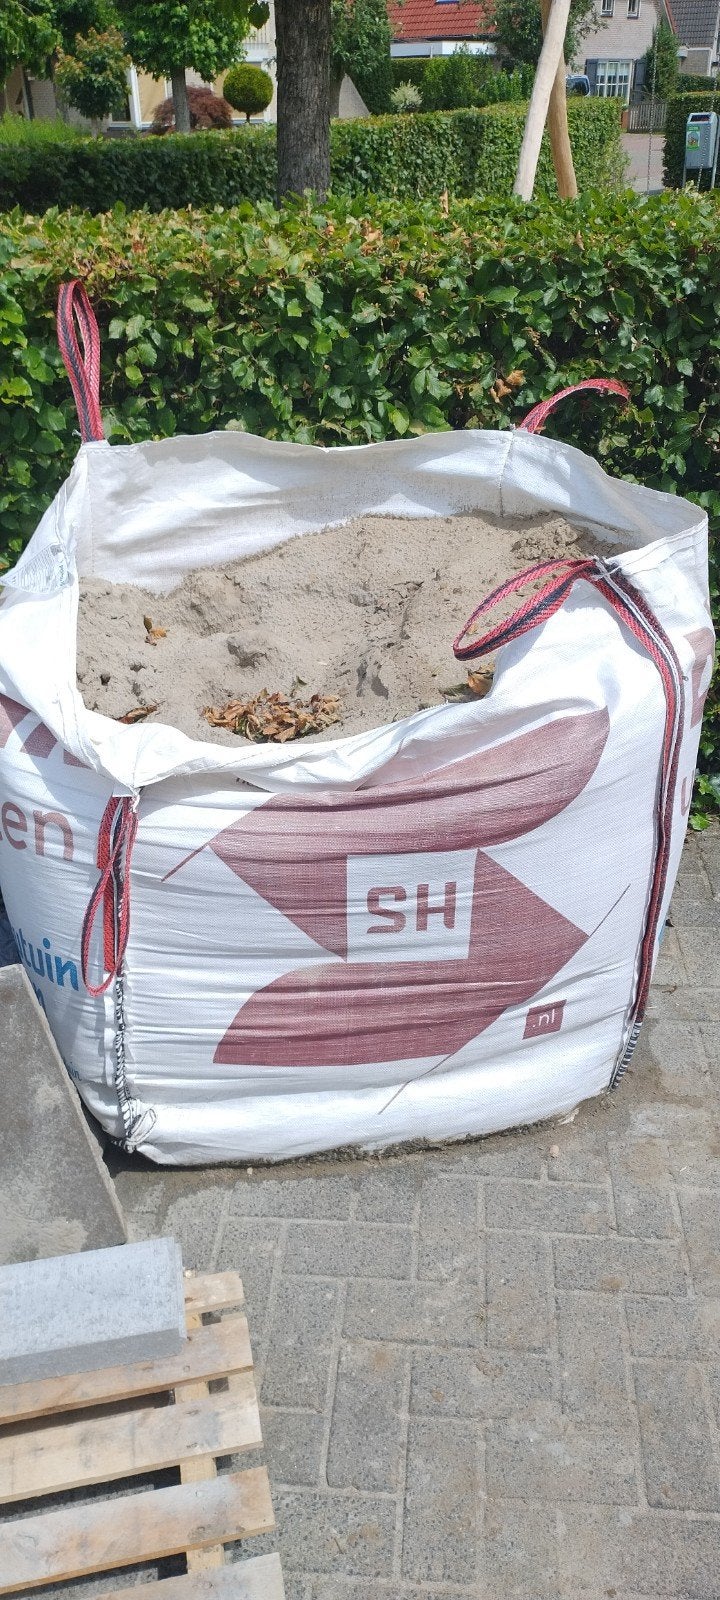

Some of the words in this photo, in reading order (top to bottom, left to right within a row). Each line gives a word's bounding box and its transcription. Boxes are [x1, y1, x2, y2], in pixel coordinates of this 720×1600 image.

[0, 801, 74, 861] en
[366, 882, 457, 934] SH
[532, 1008, 556, 1028] .nl
